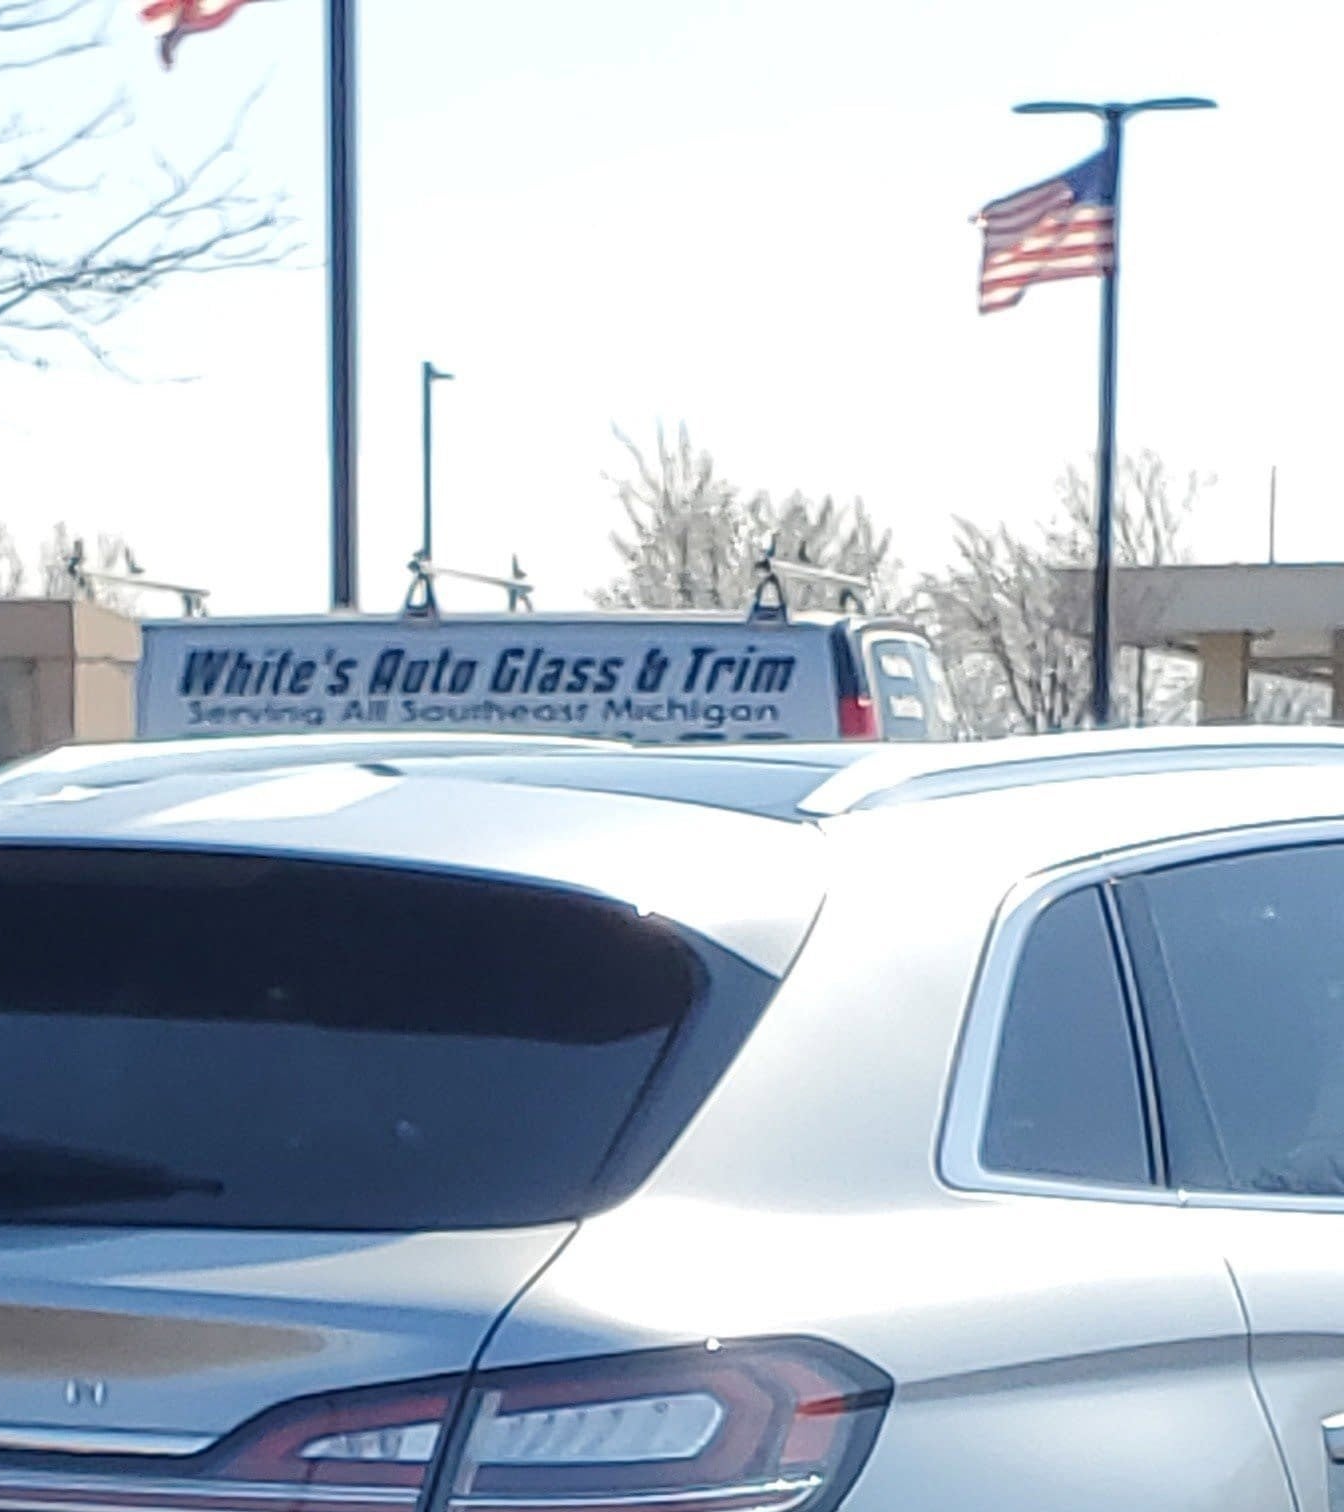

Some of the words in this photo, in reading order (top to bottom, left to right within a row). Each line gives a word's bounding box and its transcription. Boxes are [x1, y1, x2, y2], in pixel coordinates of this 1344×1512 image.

[179, 649, 358, 697] White's
[367, 648, 478, 694] Auto
[488, 648, 625, 694] Glass
[636, 648, 671, 693] &
[683, 646, 796, 693] Trim
[186, 700, 324, 725] Serving
[342, 699, 389, 721] All
[401, 699, 589, 722] Southeast
[603, 697, 780, 729] Michigan
